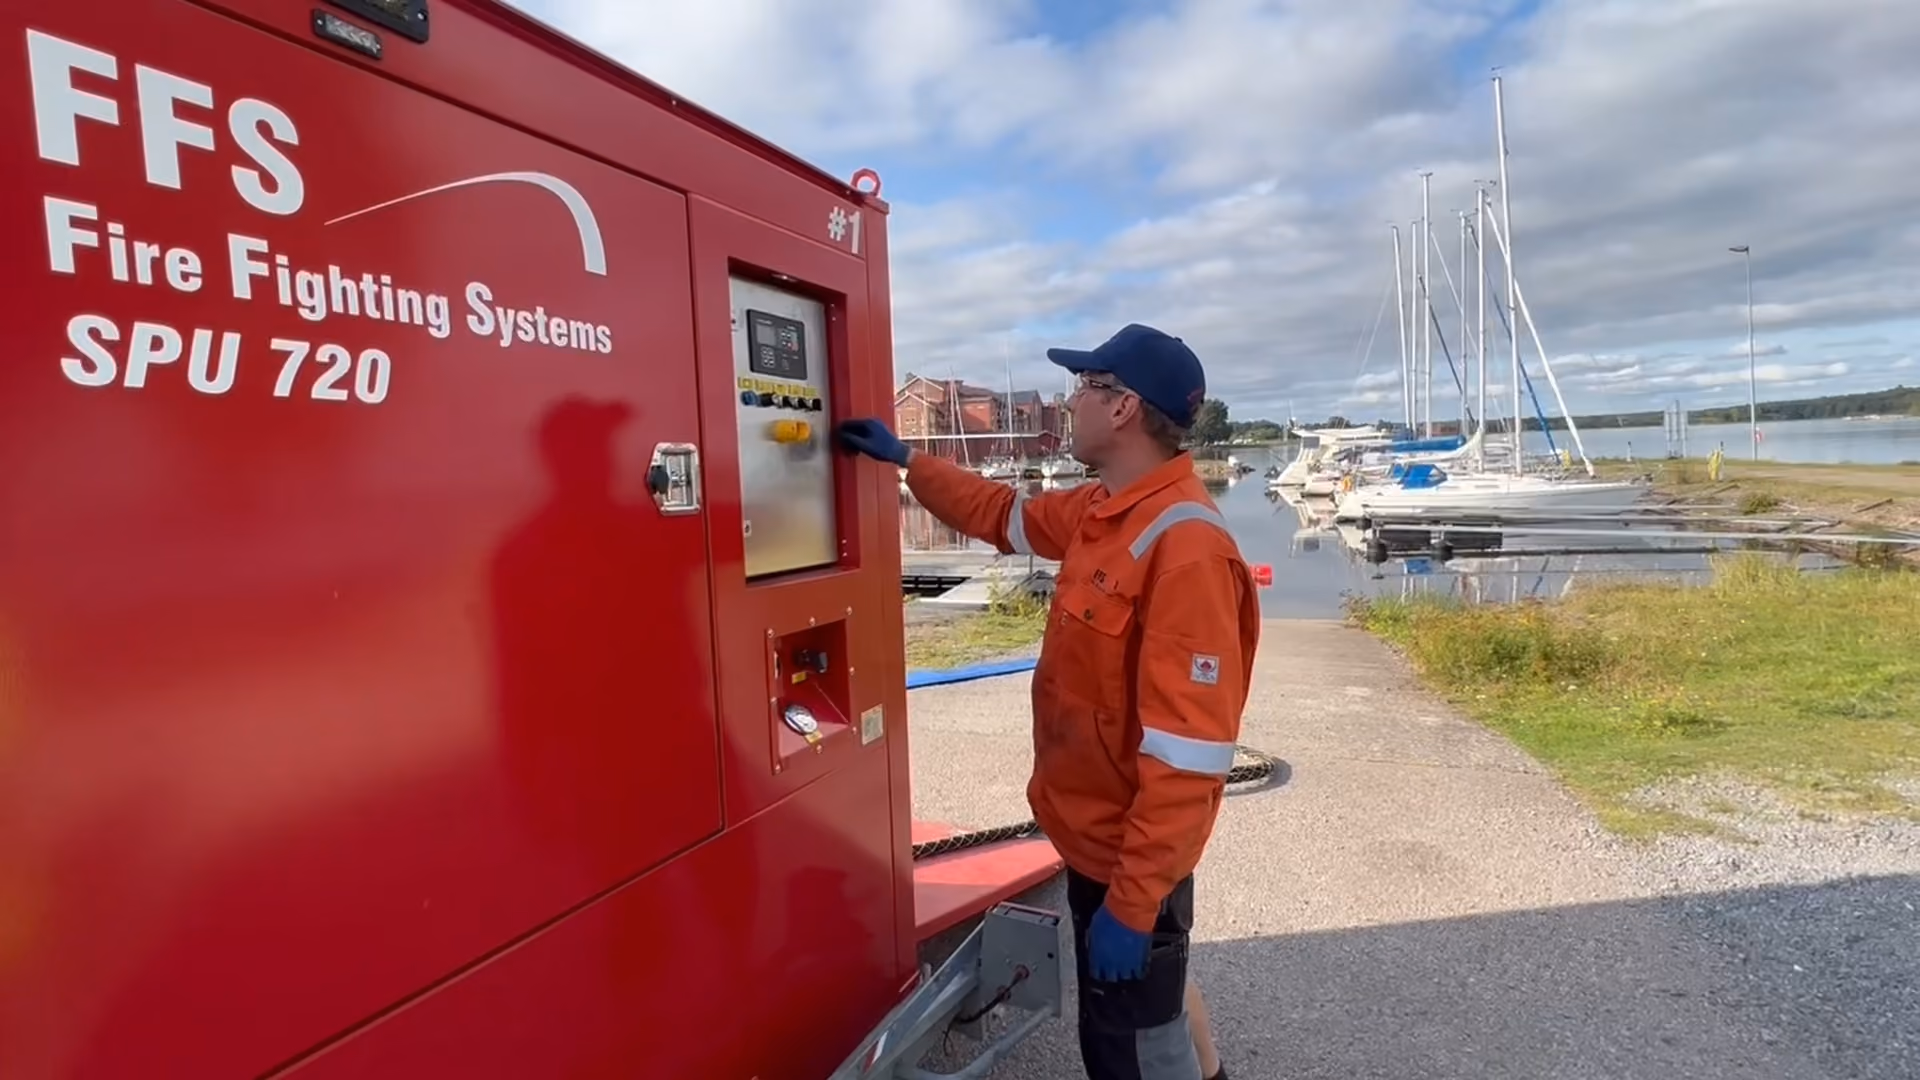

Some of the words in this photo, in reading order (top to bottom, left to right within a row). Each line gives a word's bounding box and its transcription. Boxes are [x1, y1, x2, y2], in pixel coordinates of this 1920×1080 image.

[26, 28, 304, 215] FFS
[43, 196, 203, 292] Fire
[228, 233, 451, 339] Fighting
[466, 282, 613, 354] Systems
[828, 206, 861, 254] #1
[60, 314, 241, 394] SPU
[270, 338, 391, 404] 720
